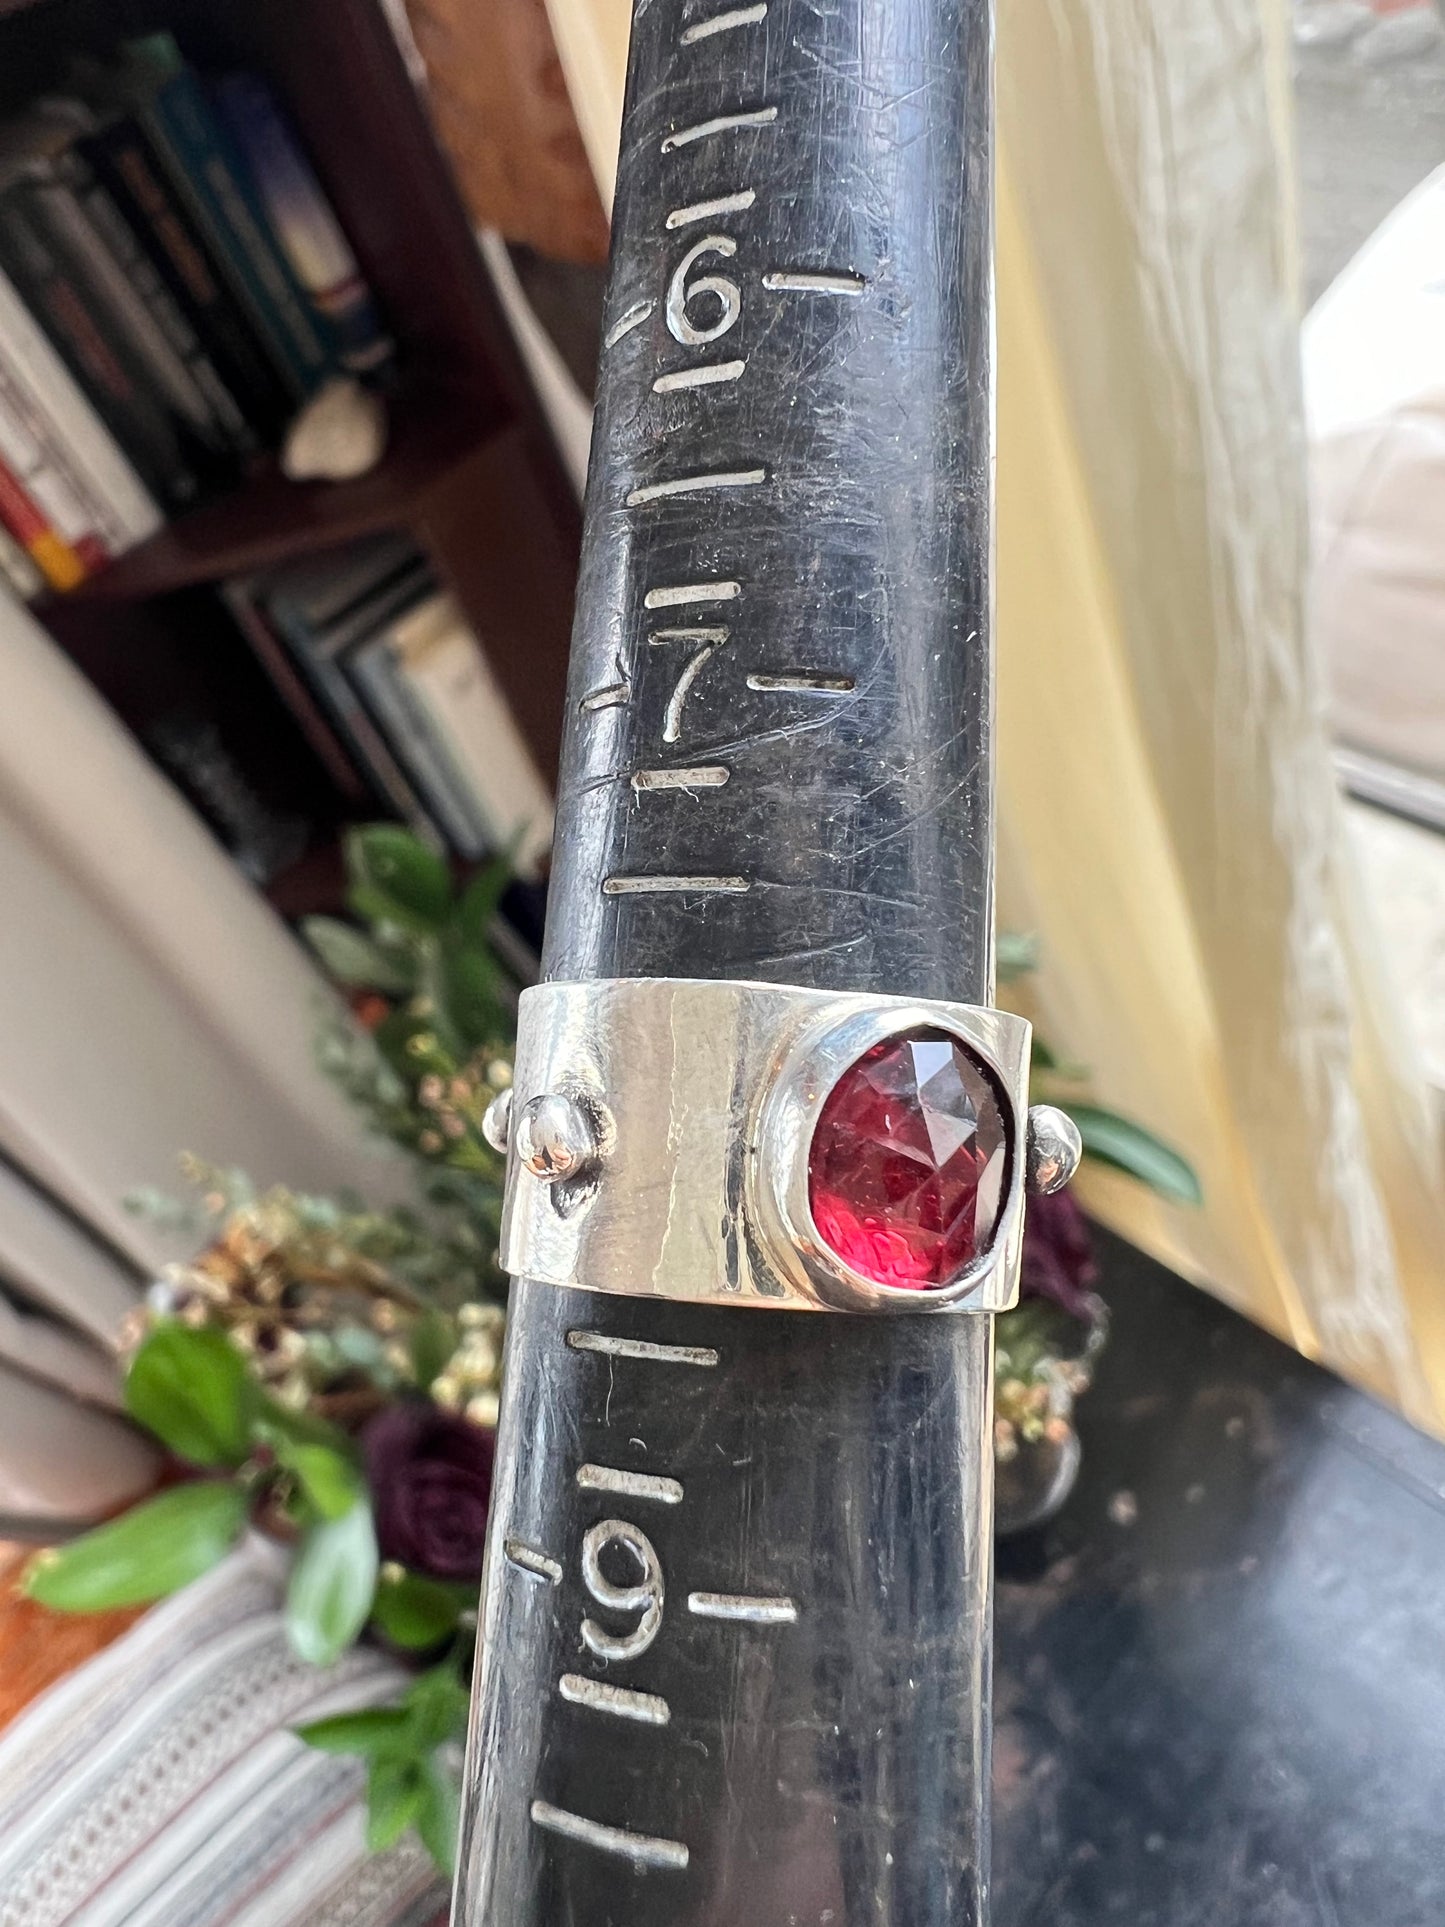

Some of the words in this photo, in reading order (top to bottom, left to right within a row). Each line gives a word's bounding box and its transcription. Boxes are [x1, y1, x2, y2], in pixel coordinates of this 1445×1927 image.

[666, 234, 741, 345] 6
[648, 624, 731, 742] 7
[581, 1519, 665, 1660] 9
